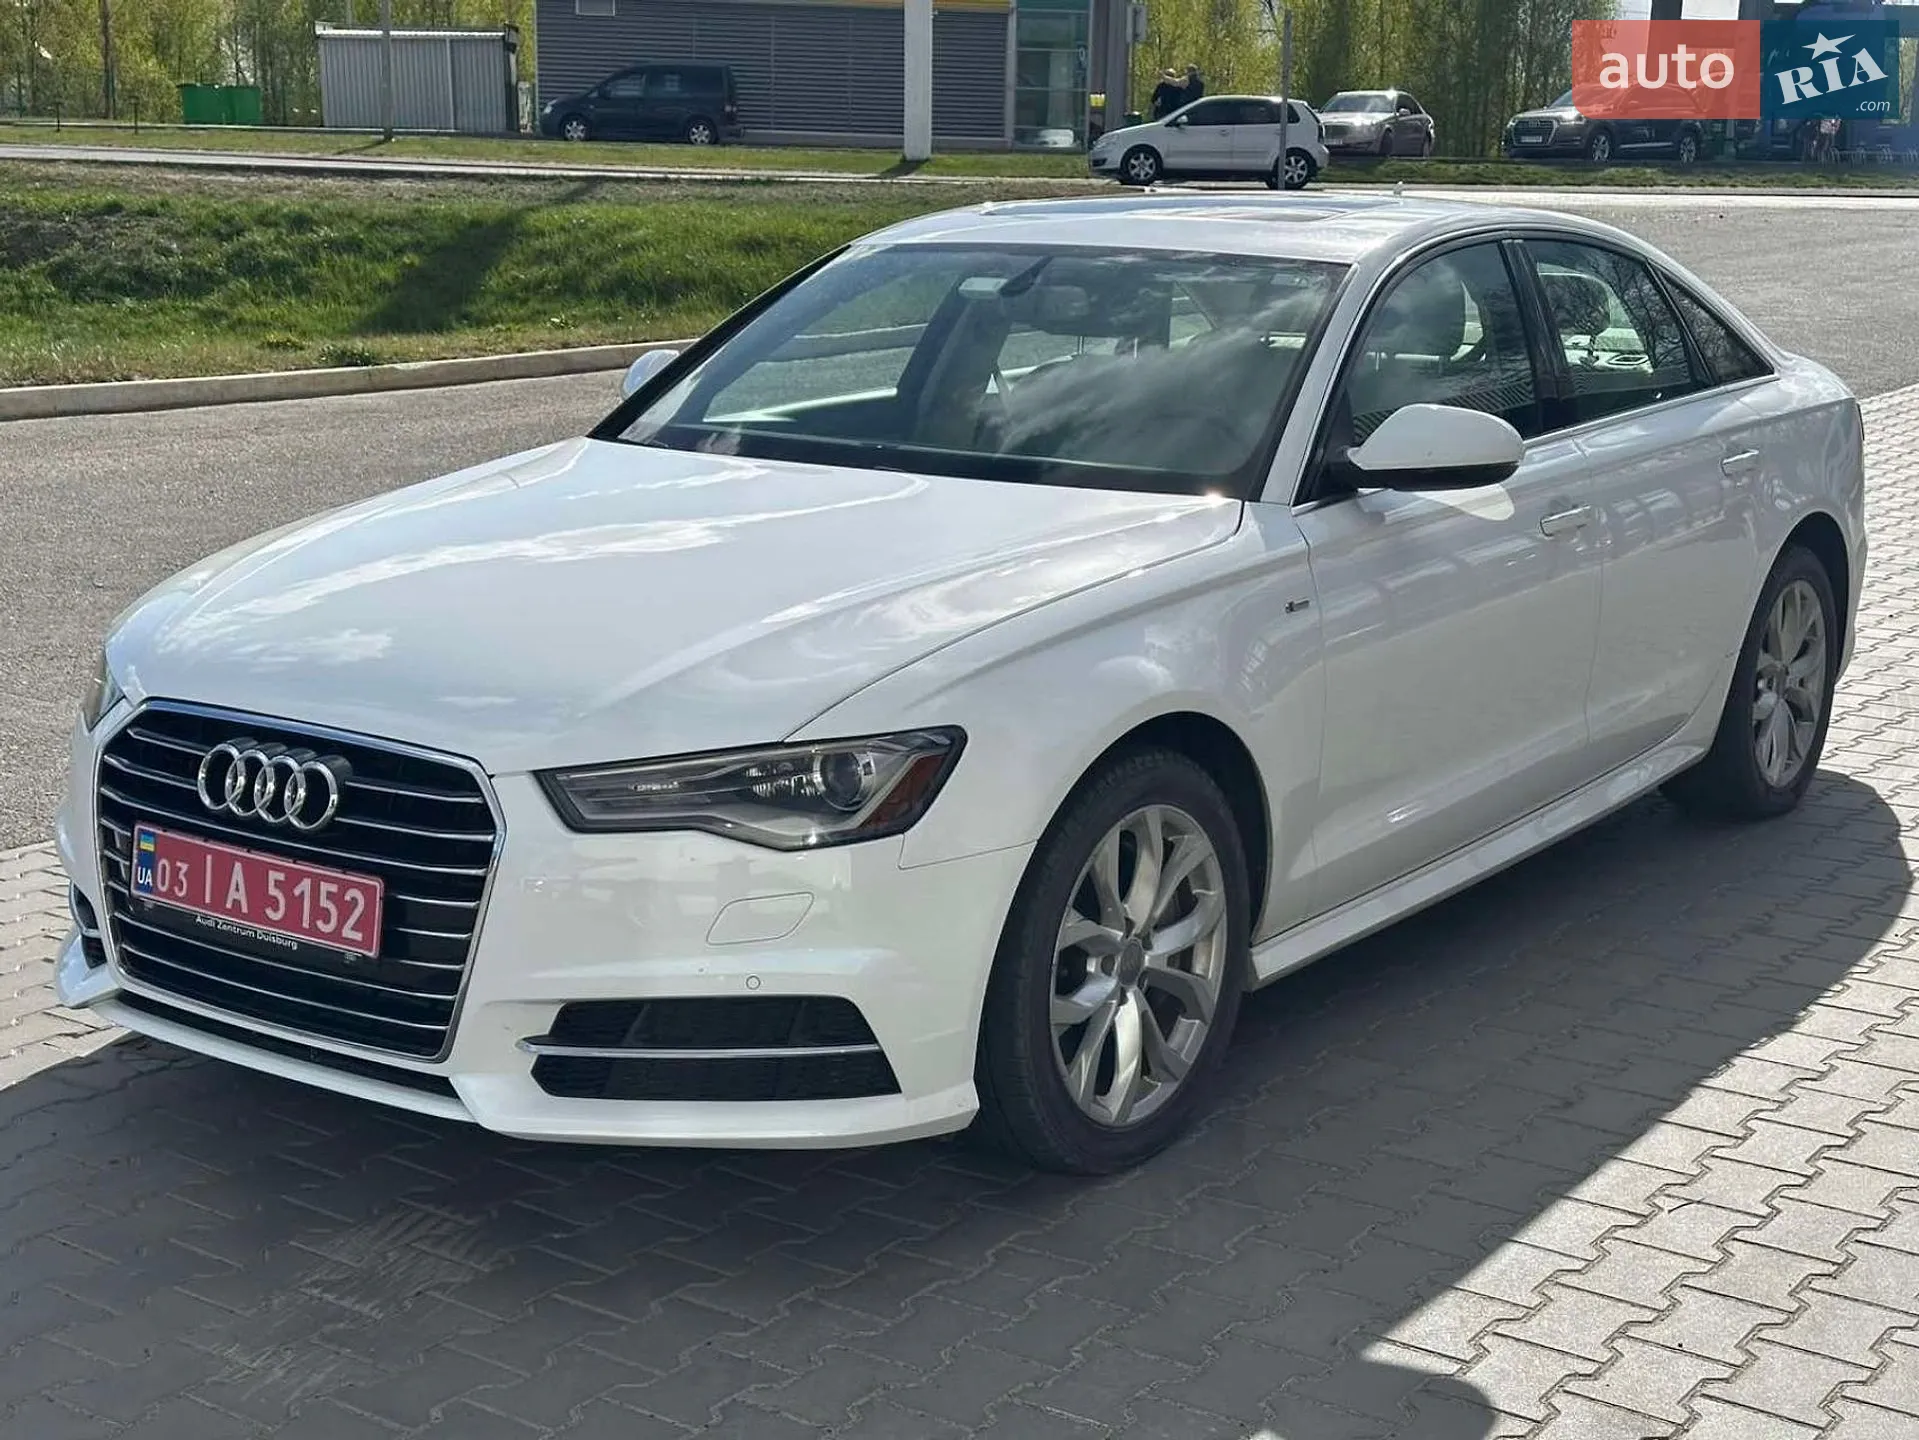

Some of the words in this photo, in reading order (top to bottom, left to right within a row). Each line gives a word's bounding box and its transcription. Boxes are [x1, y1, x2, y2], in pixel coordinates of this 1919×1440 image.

[137, 866, 153, 887] UA
[156, 858, 189, 898] 03
[264, 869, 365, 942] 5152
[195, 914, 216, 928] Audi
[216, 920, 255, 938] Zentrum
[256, 929, 298, 951] Duisburg
